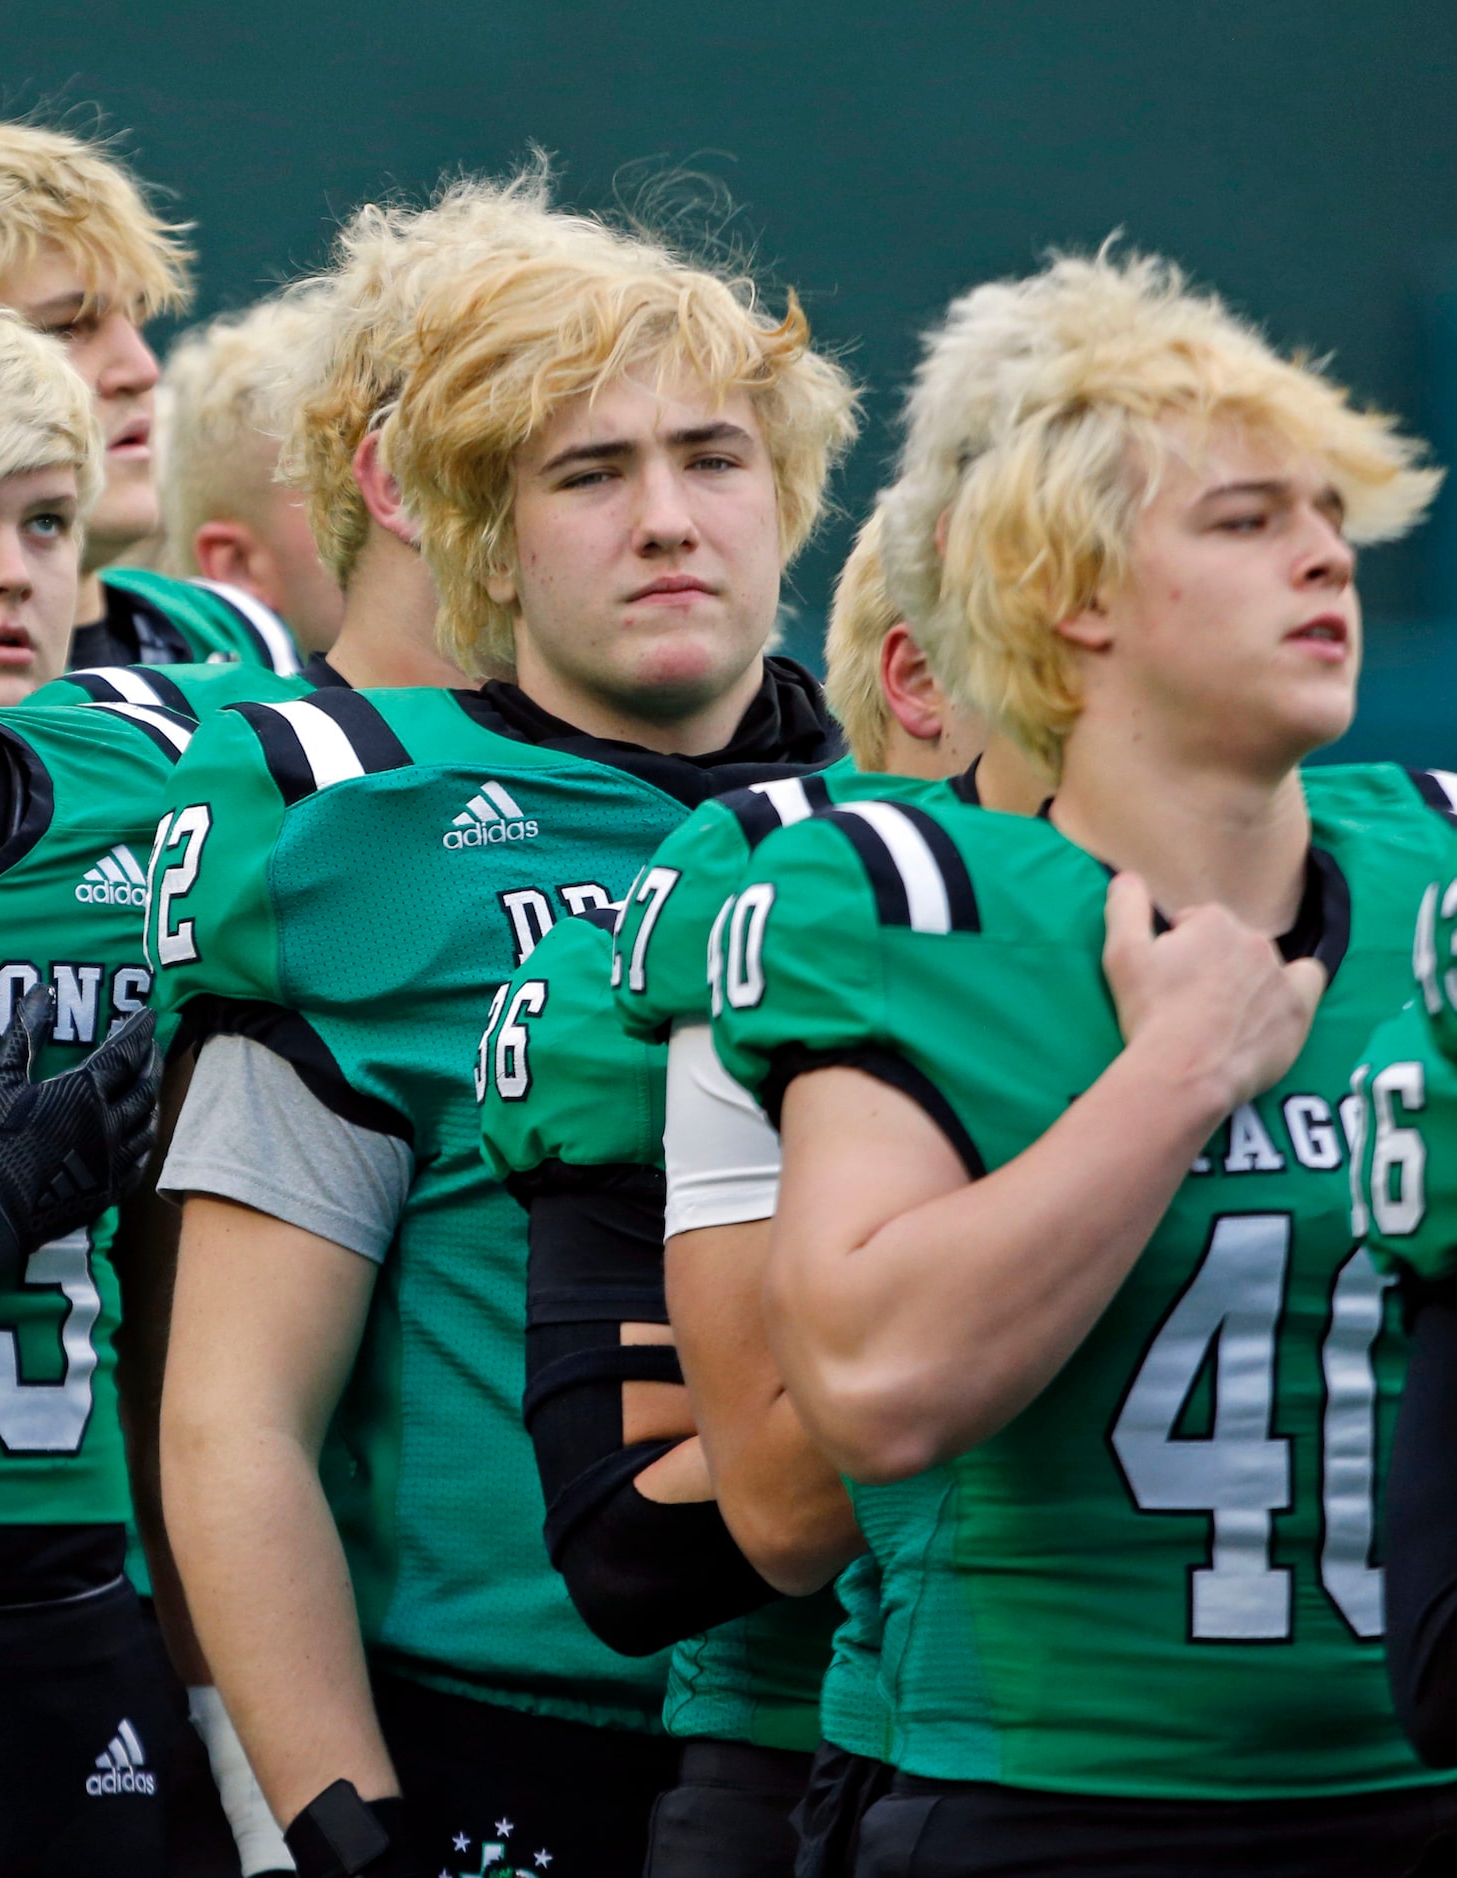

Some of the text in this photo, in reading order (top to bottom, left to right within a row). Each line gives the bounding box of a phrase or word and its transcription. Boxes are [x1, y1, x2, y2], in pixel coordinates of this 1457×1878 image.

[443, 819, 539, 850] adidas
[74, 878, 147, 907] adida
[1192, 1093, 1366, 1174] AG
[85, 1765, 155, 1796] adidas
